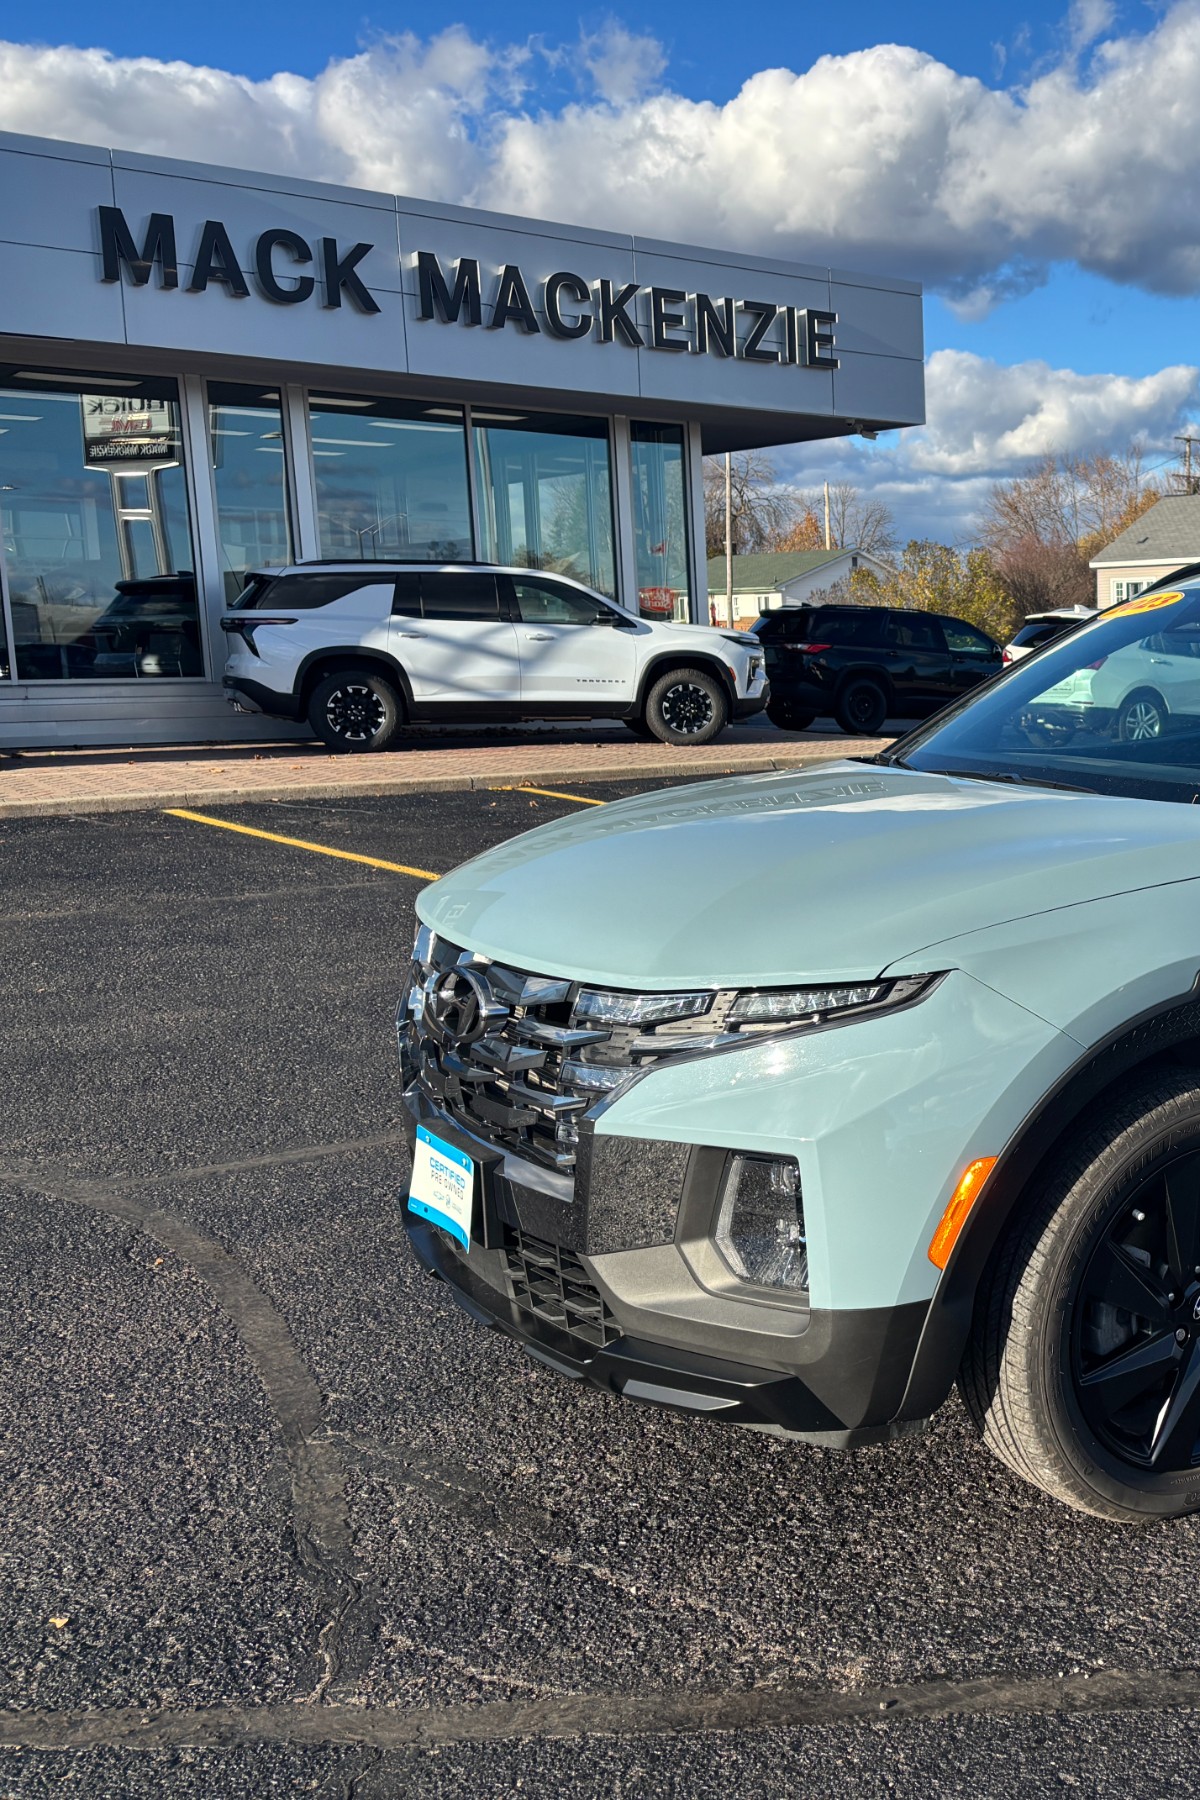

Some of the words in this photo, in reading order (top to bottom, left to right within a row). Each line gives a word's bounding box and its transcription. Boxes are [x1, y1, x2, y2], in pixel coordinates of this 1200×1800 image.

[96, 205, 382, 315] MACK
[411, 251, 840, 369] MACKENZIE
[429, 1157, 466, 1188] CERTIFIED
[430, 1168, 443, 1185] PRE
[444, 1175, 465, 1200] OWNED
